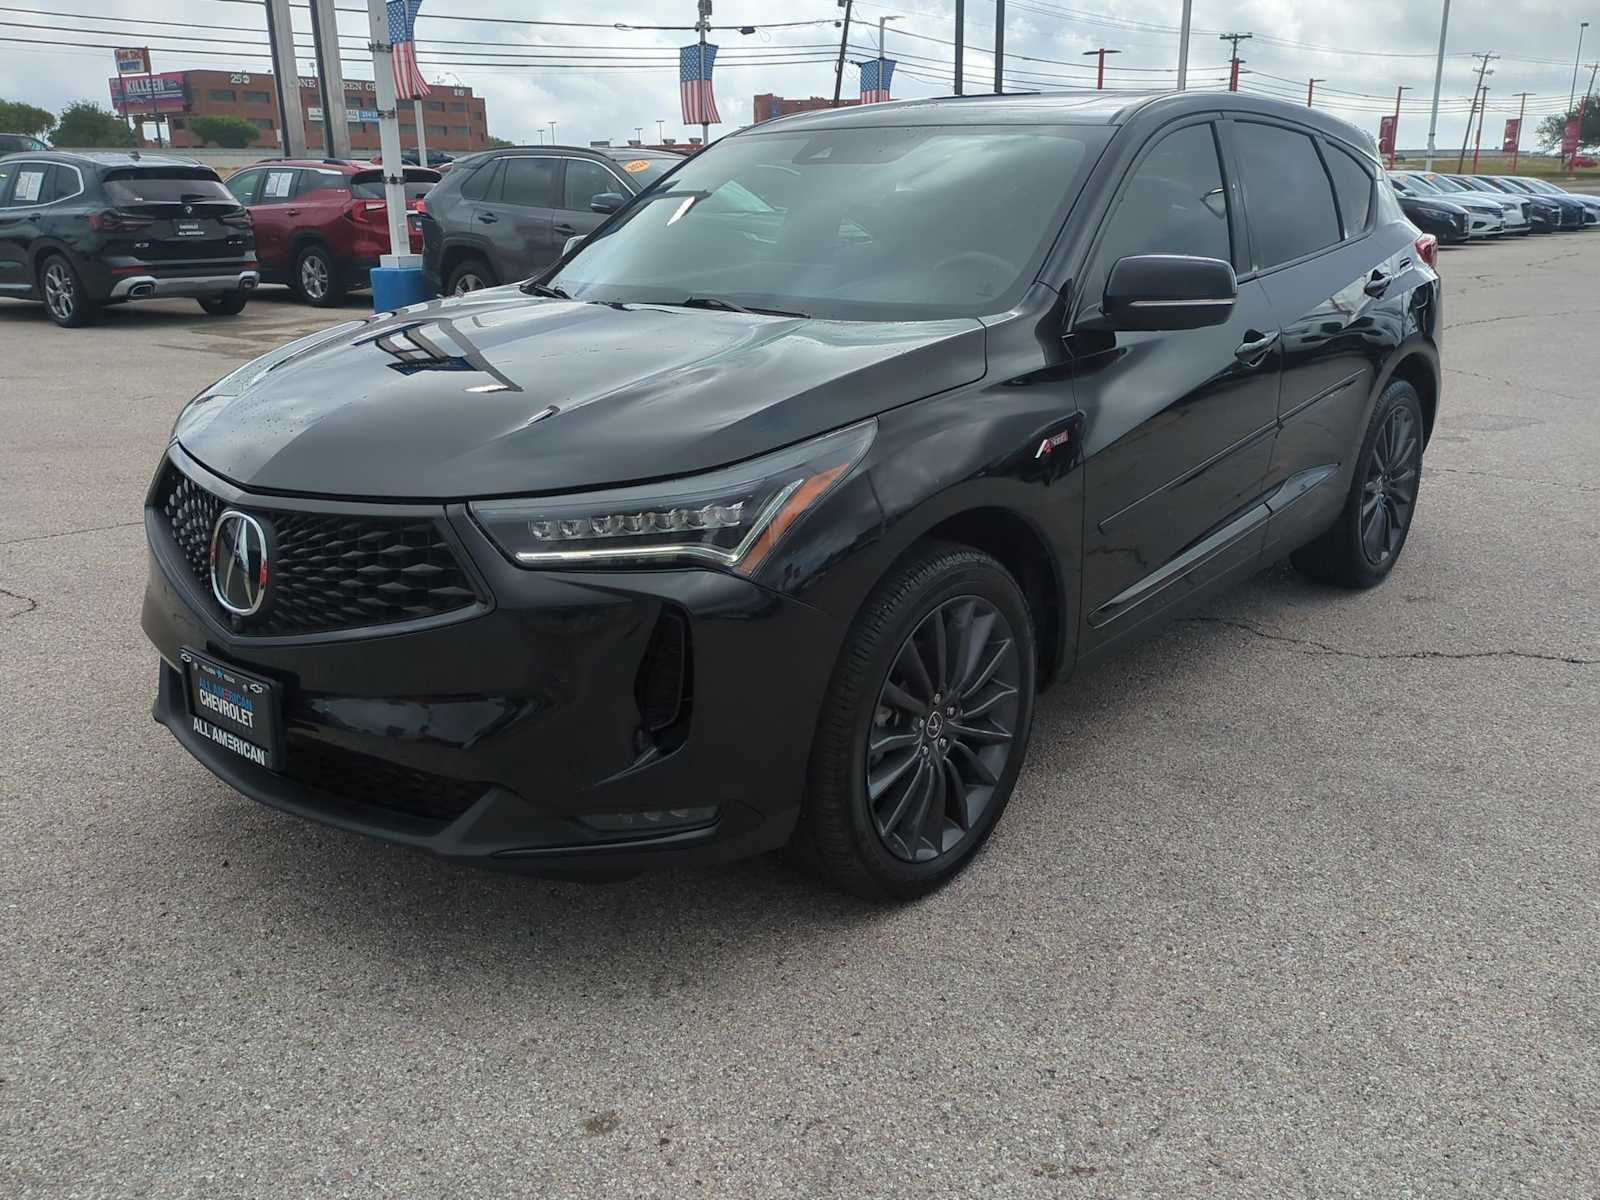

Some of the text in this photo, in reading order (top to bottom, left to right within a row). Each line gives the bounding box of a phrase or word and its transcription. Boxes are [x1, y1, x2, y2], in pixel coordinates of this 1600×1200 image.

[127, 78, 165, 95] KILLEEN
[199, 677, 211, 691] ALL
[212, 684, 254, 711] AMERICAN
[200, 689, 254, 728] CHEVROLET
[193, 717, 265, 766] ALL AMERICAN
